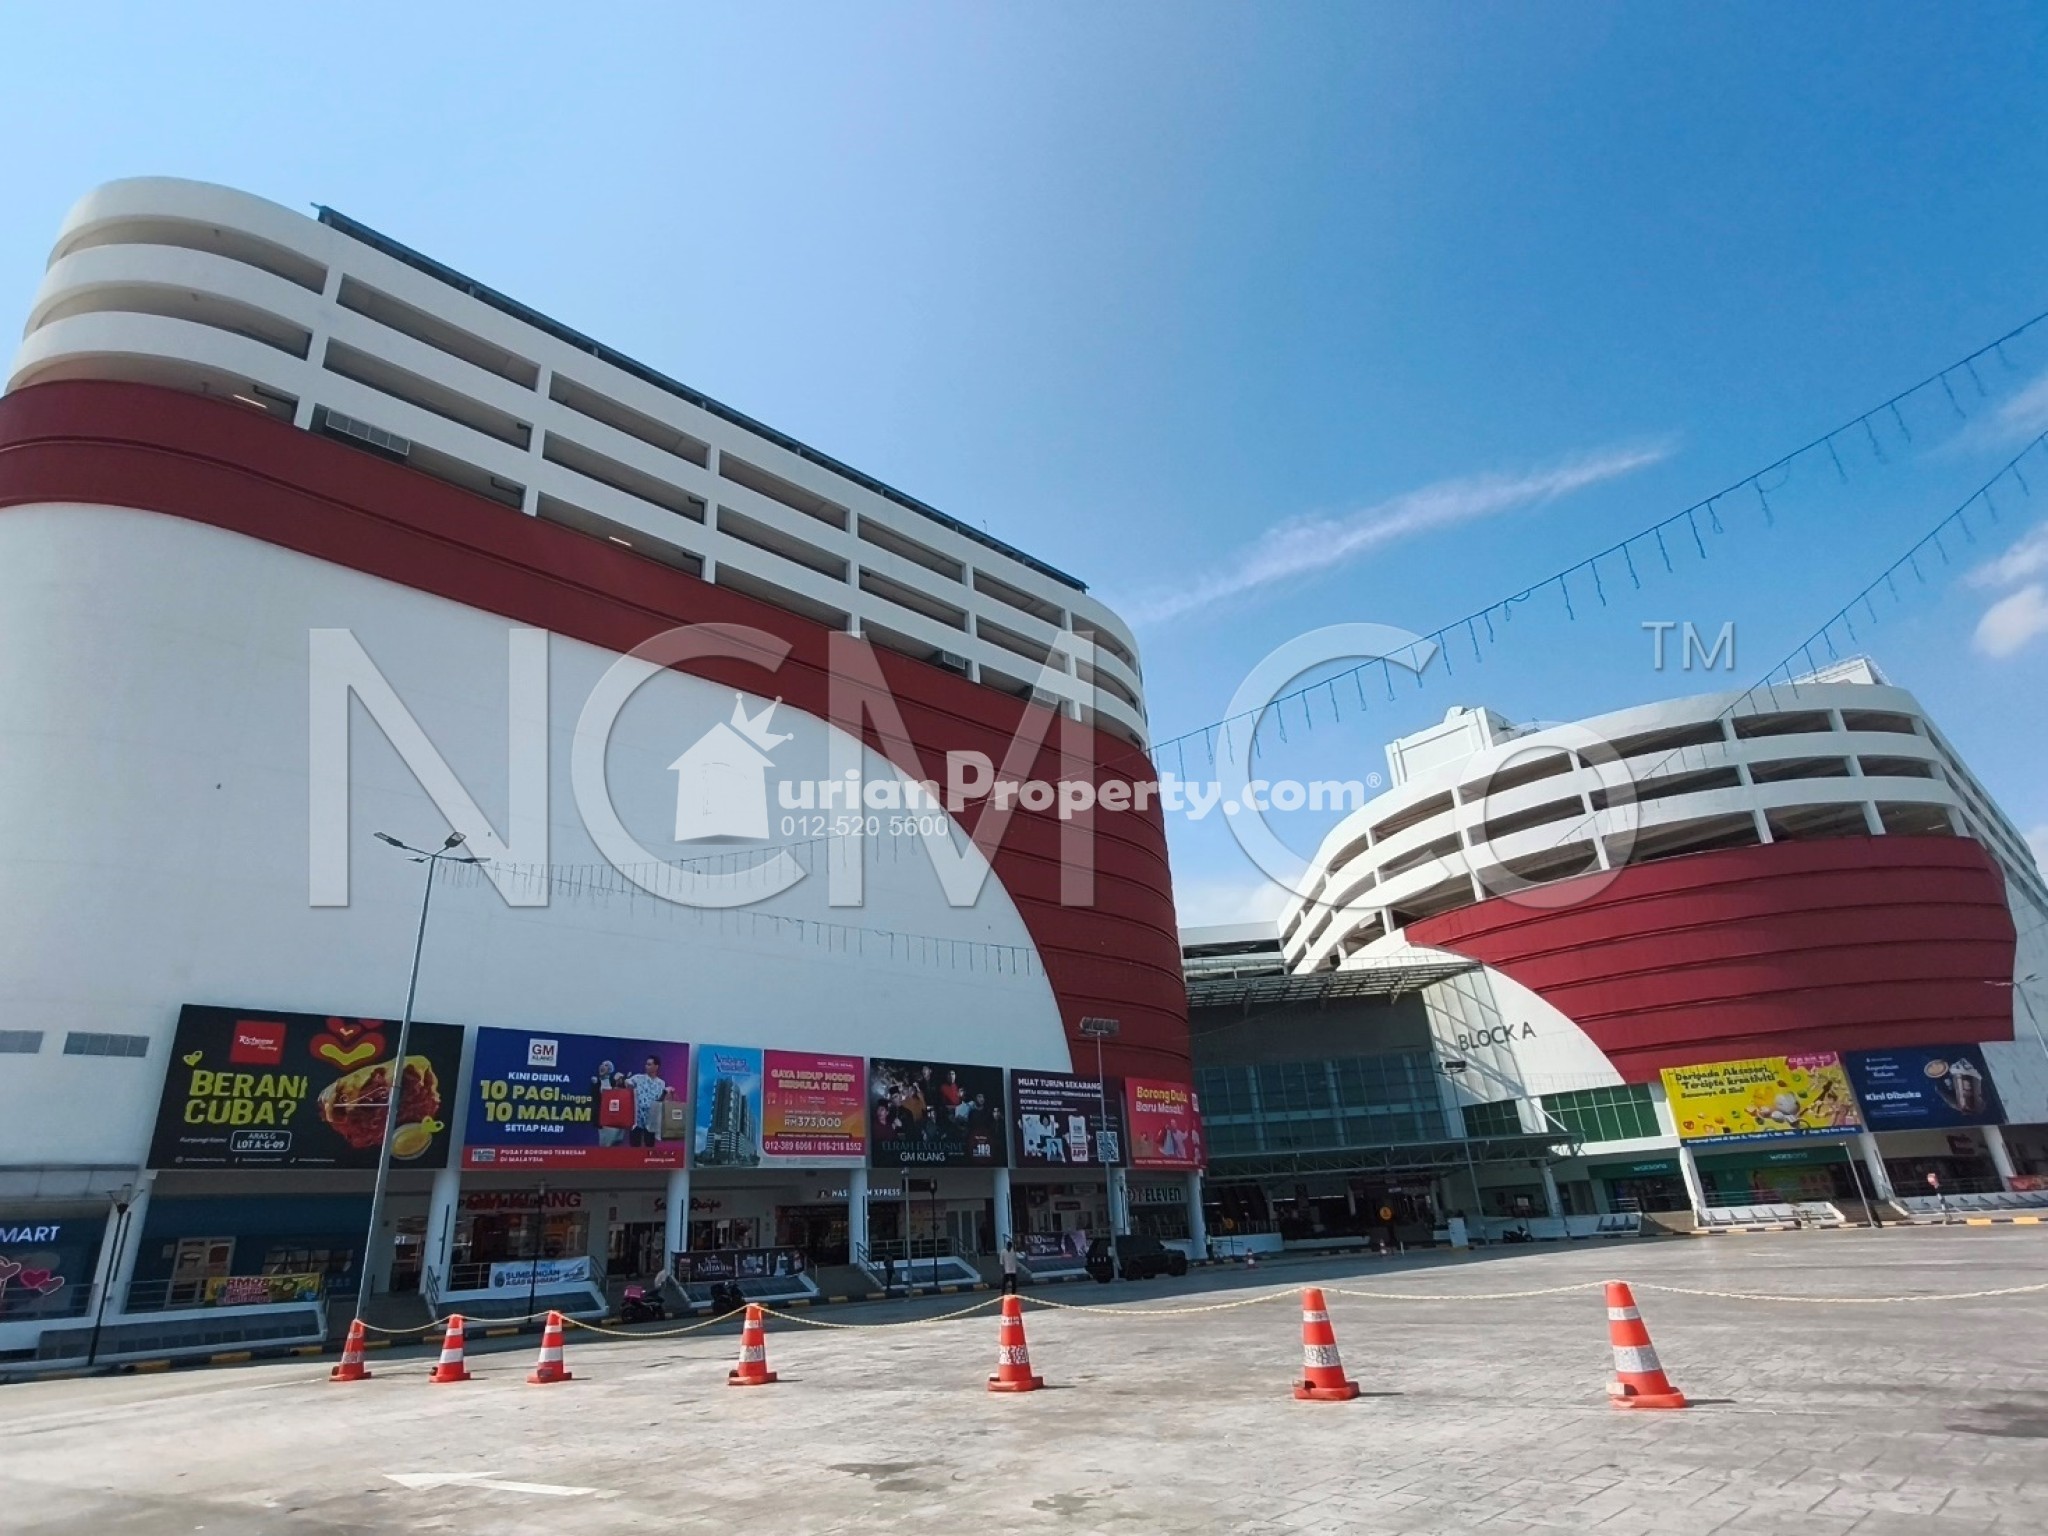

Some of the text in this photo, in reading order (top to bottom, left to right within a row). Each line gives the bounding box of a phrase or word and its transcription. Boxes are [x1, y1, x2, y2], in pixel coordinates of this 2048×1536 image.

[1458, 1021, 1536, 1051] BLOCK A
[532, 1044, 555, 1056] GM
[508, 1071, 570, 1083] KINI DIBUKA
[1018, 1078, 1039, 1086] MUAT
[189, 1069, 308, 1099] BERANI
[480, 1079, 593, 1104] 10 PAGI hingga
[1137, 1086, 1171, 1104] Borong
[1886, 1091, 1921, 1100] Dibuka
[183, 1099, 297, 1125] CUBA?
[485, 1102, 592, 1122] 10 MALAM
[1135, 1101, 1157, 1112] Baru
[505, 1124, 564, 1134] SETIAP HARI
[236, 1141, 252, 1149] LOT
[900, 1152, 916, 1161] GM
[917, 1152, 946, 1161] KLANG
